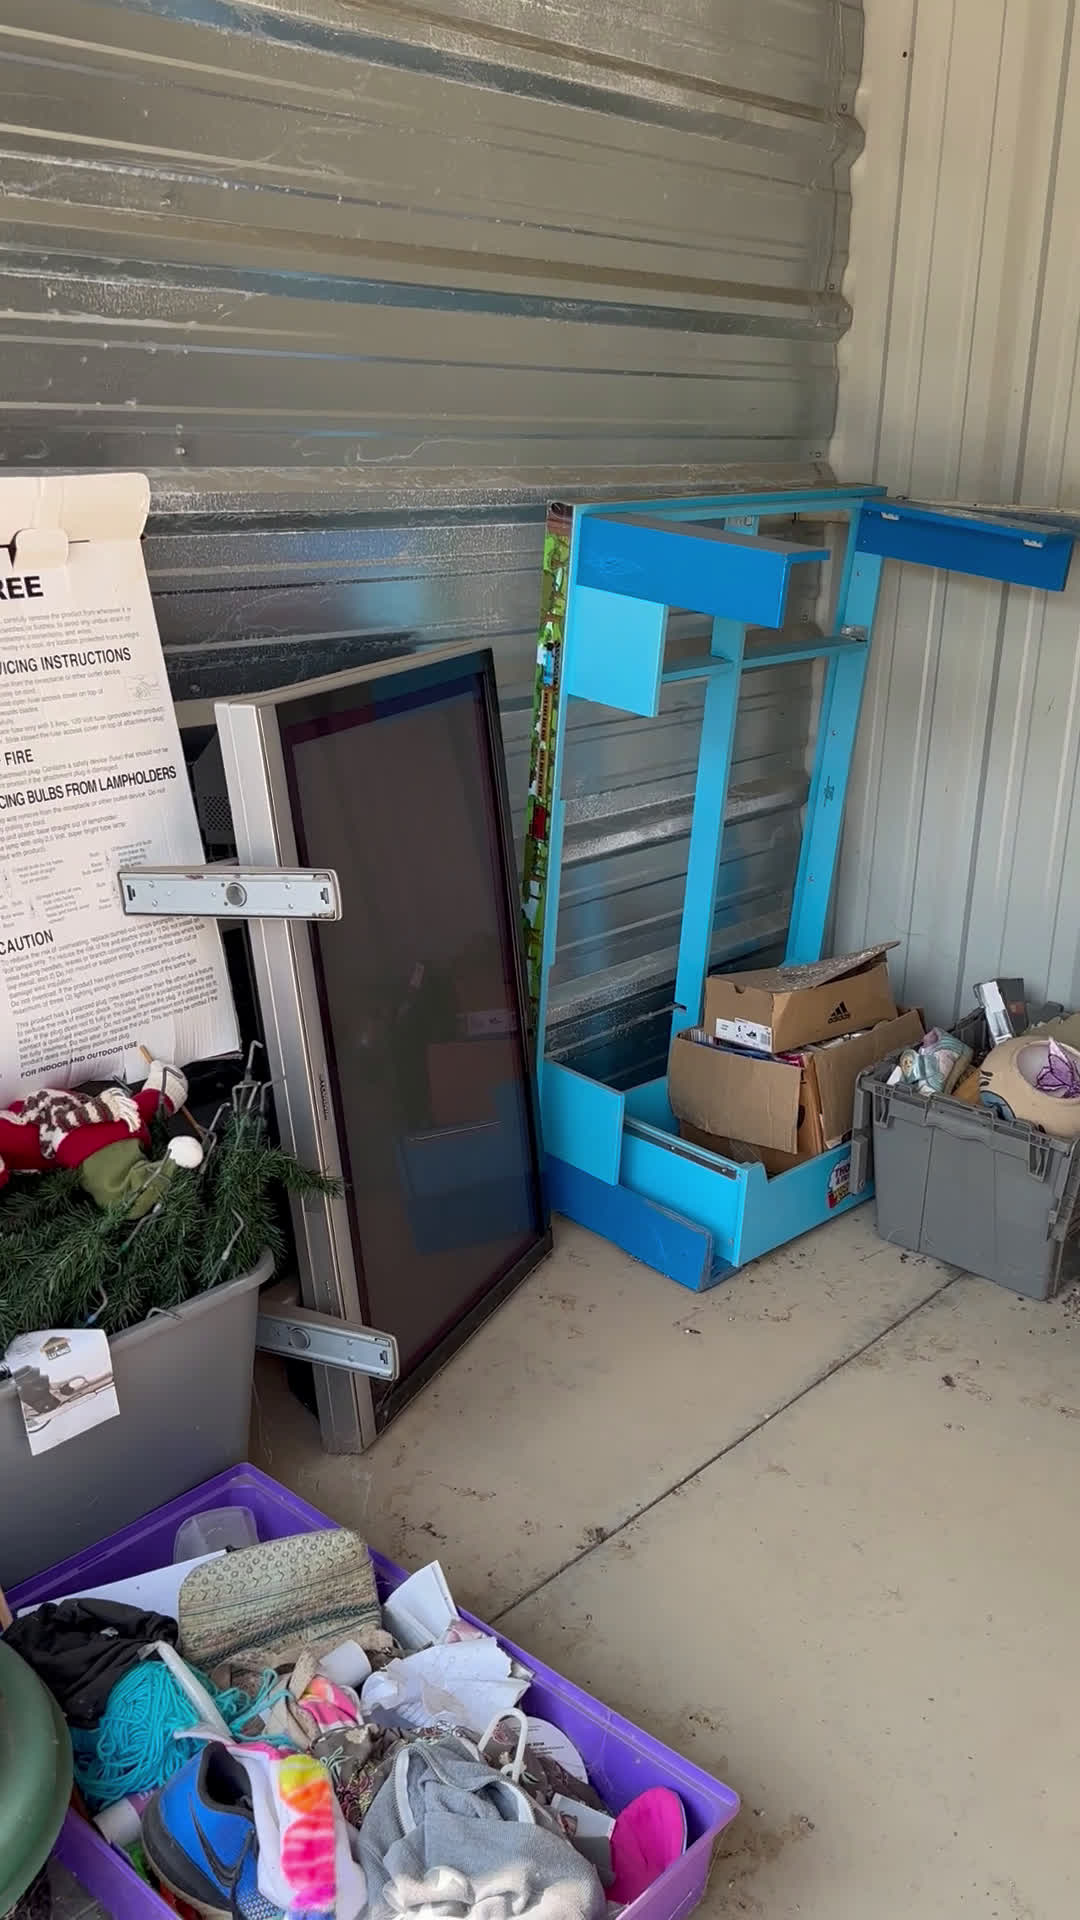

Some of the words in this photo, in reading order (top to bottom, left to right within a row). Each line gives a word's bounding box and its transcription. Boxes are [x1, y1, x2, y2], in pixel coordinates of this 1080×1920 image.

[0, 658, 38, 675] ICING
[41, 647, 132, 670] INSTRUCTIONS
[5, 748, 34, 766] FIRE
[27, 785, 64, 804] BULBS
[66, 779, 98, 797] FROM
[99, 765, 177, 791] LAMPHOLDERS
[0, 929, 54, 955] CAUTION
[828, 1012, 851, 1025] adidas
[20, 1068, 36, 1078] FOR
[37, 1059, 68, 1074] INDOOR
[68, 1054, 85, 1065] AND
[86, 1044, 123, 1060] OUTDOOR
[124, 1040, 137, 1050] USE
